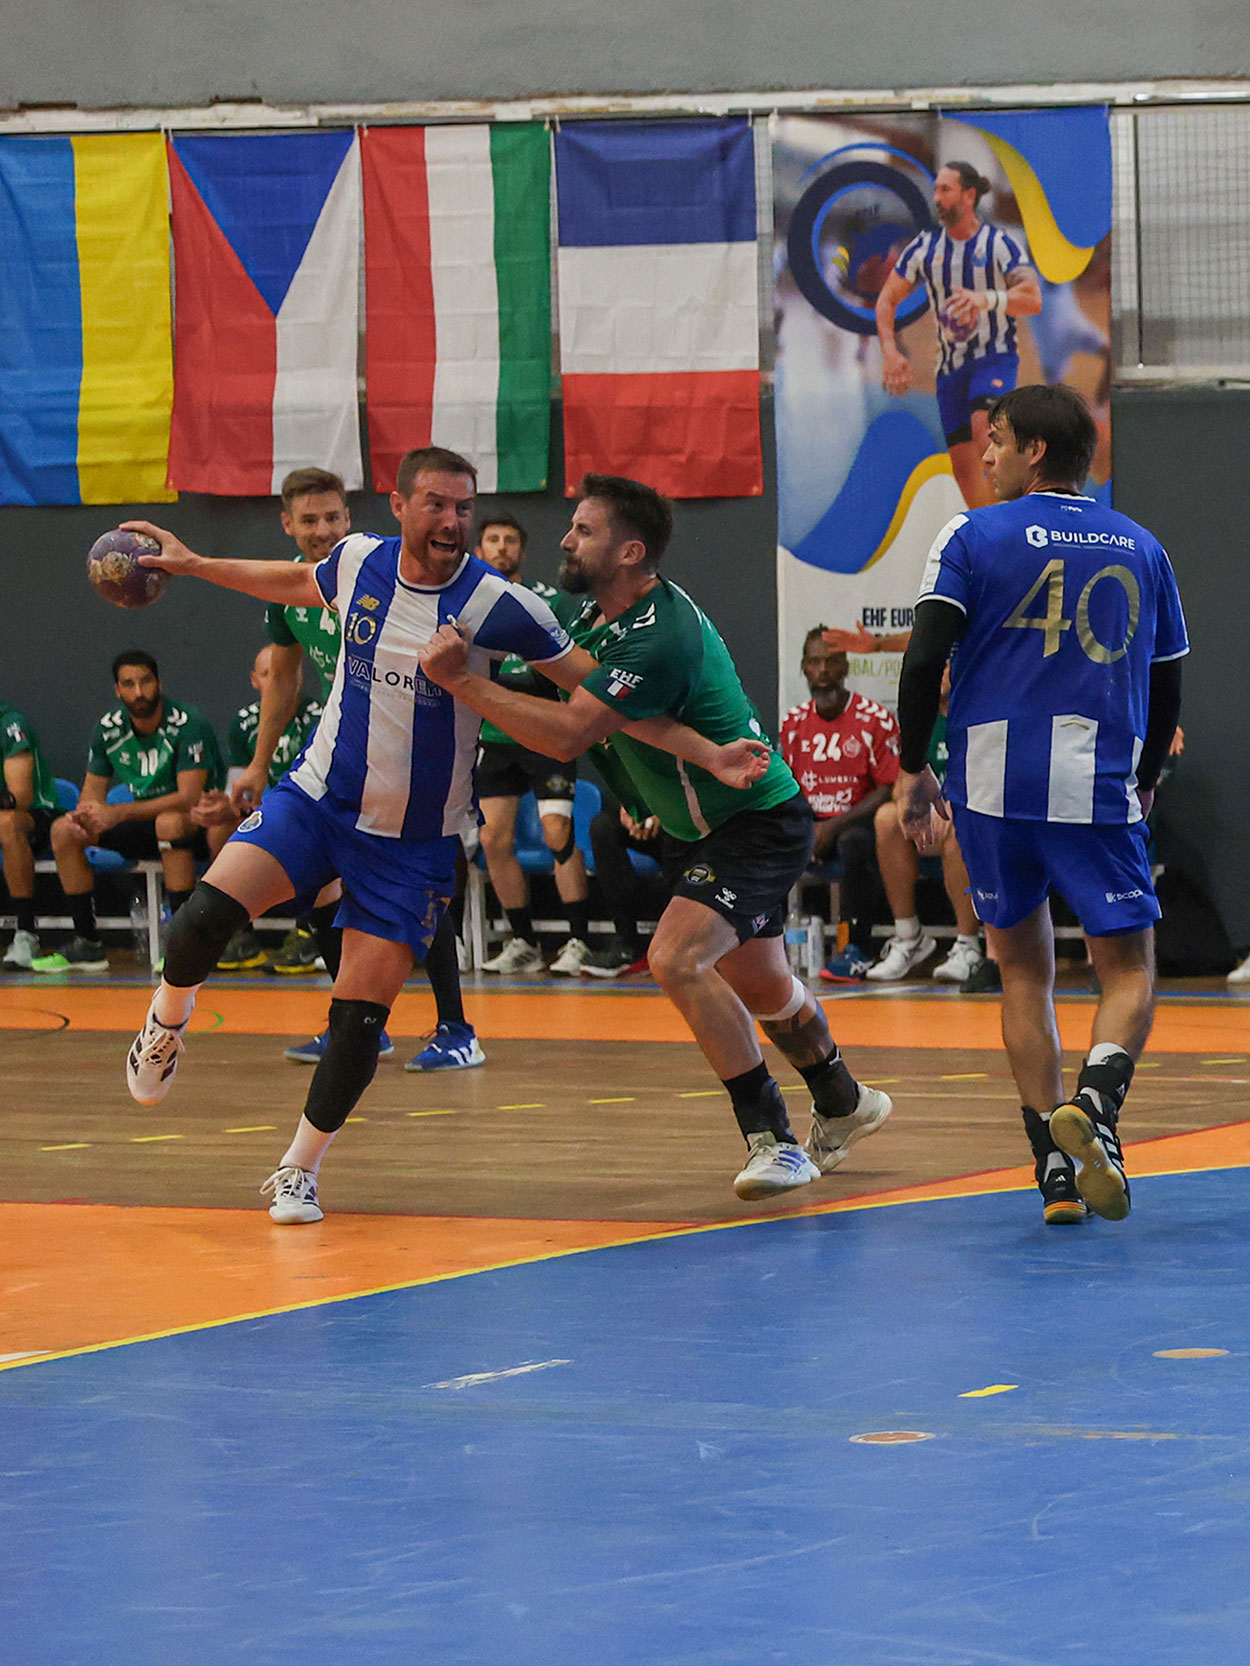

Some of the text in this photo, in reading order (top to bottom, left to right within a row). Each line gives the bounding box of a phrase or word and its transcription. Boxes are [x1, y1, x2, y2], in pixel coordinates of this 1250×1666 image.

[1050, 530, 1136, 551] BUILDCARE
[862, 607, 915, 628] EHF EUR
[1002, 558, 1141, 664] 40
[346, 612, 377, 645] 10
[609, 668, 643, 684] EHF
[812, 732, 842, 762] 24
